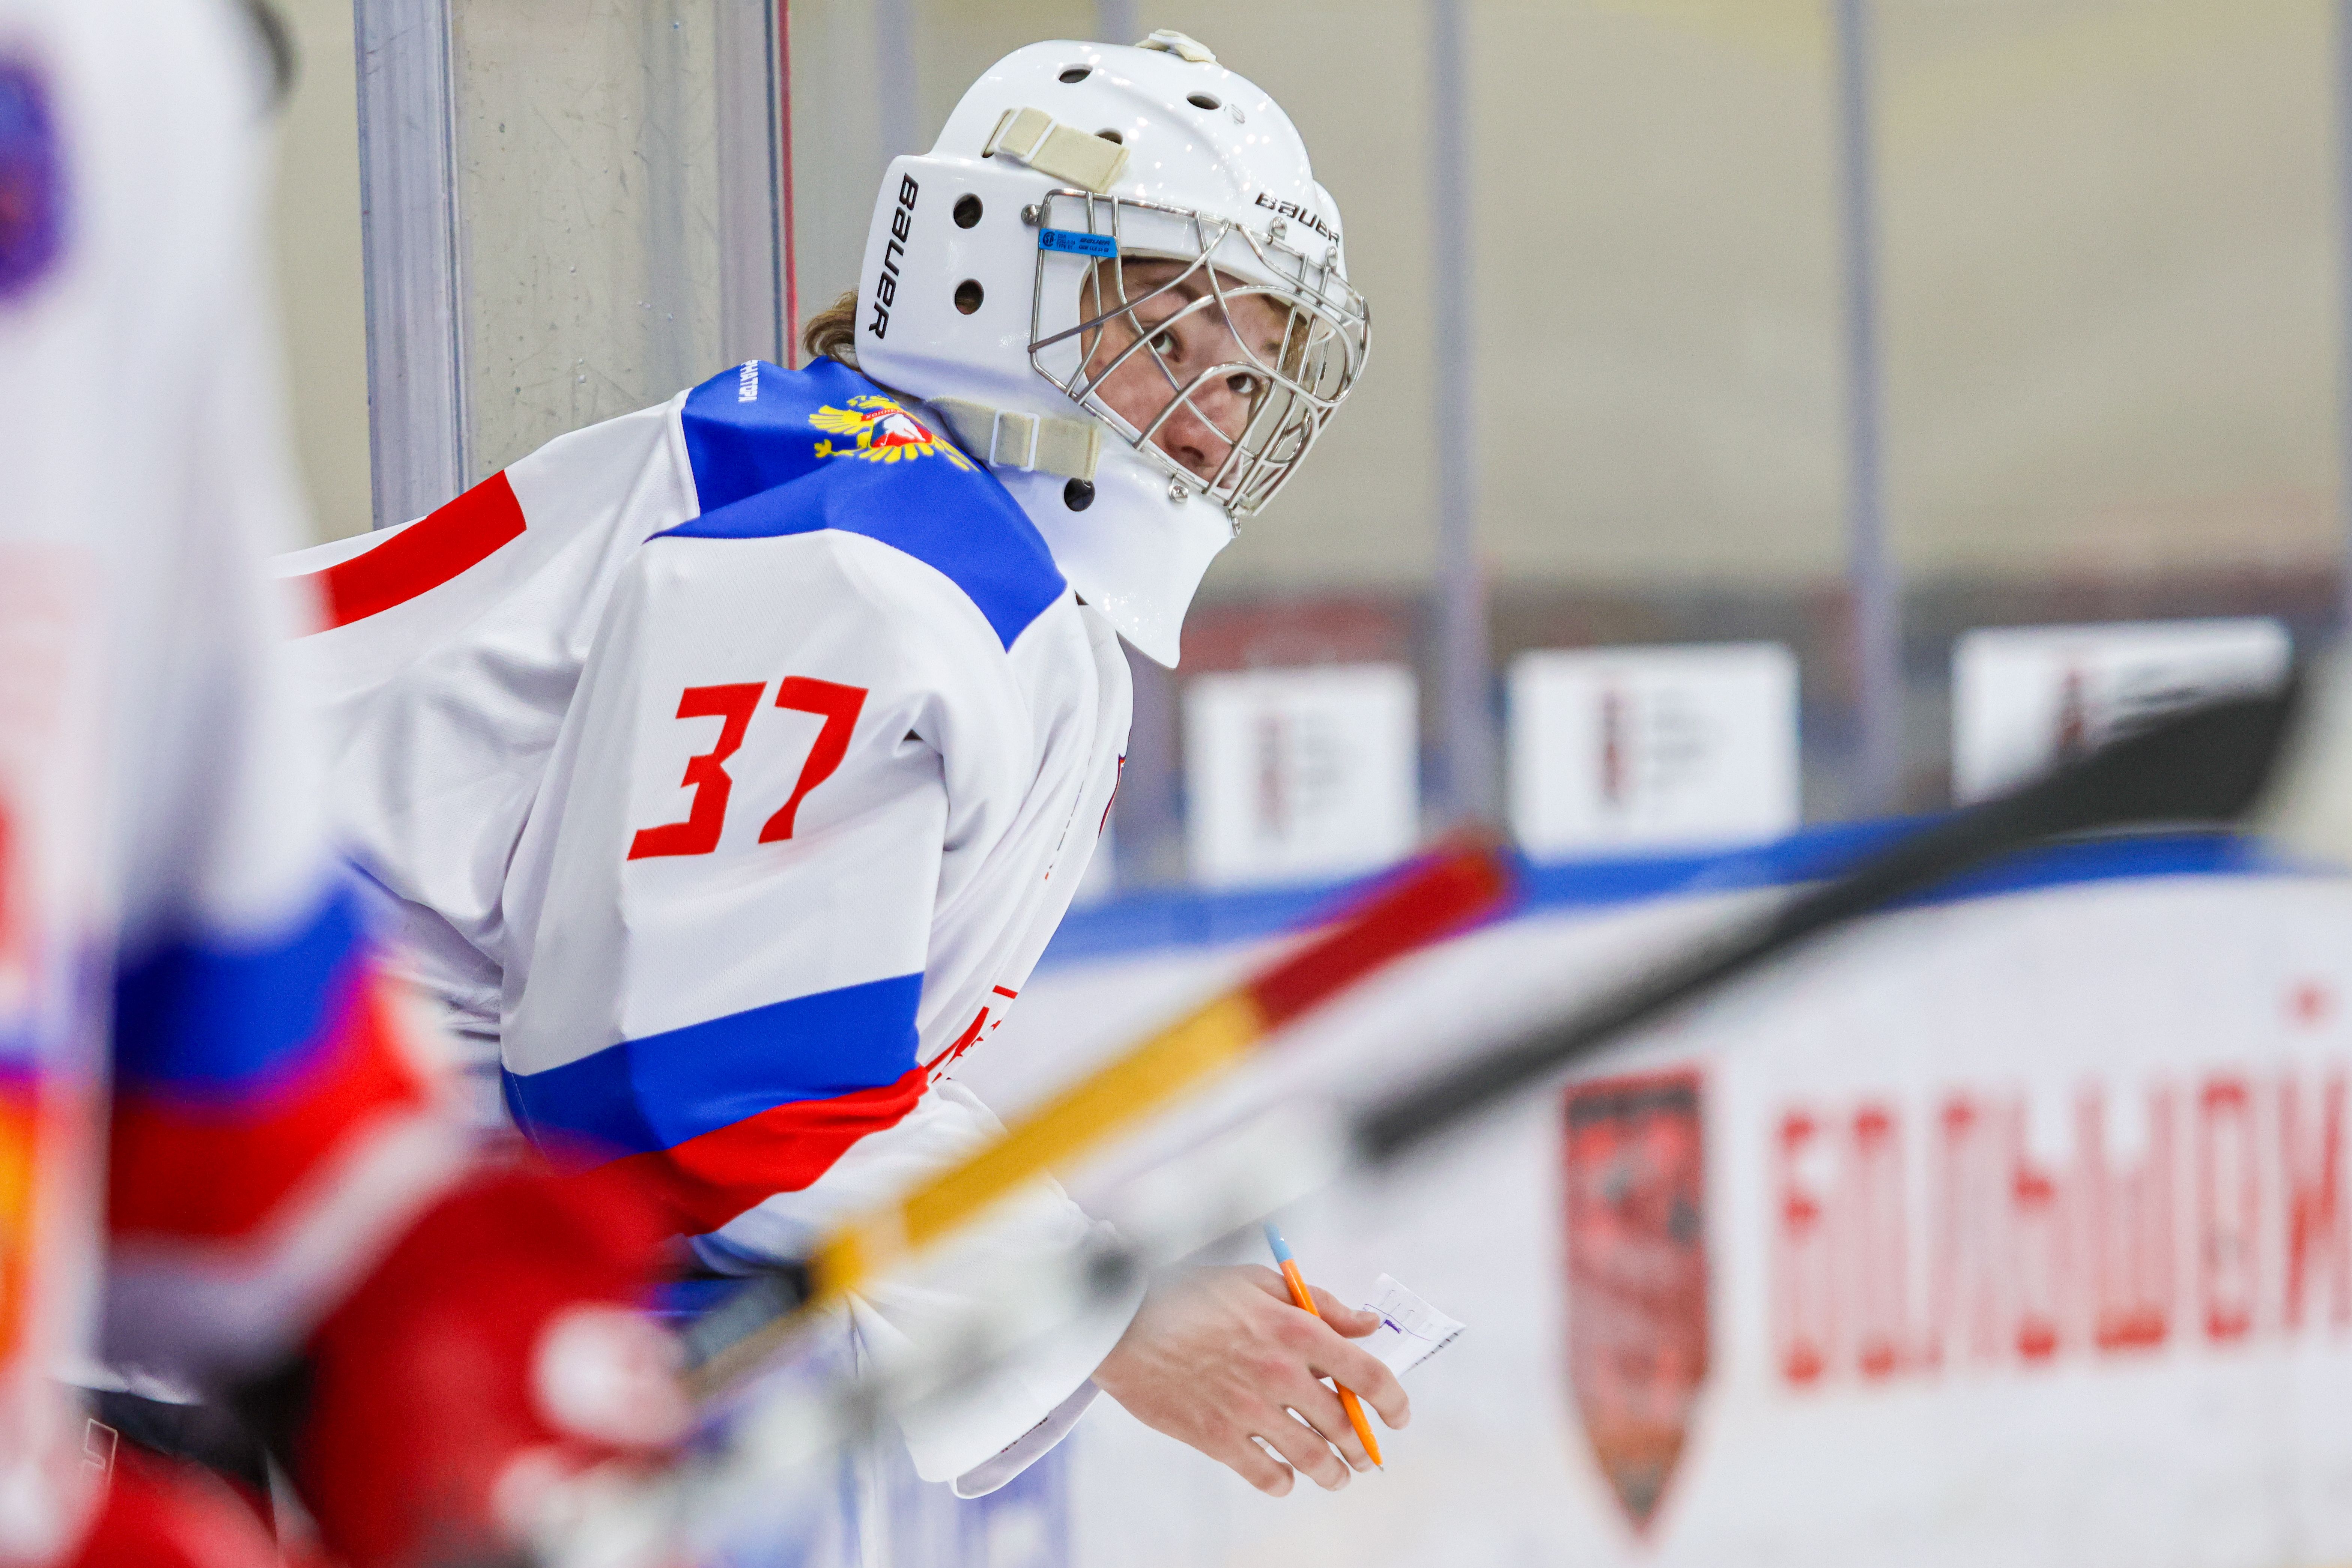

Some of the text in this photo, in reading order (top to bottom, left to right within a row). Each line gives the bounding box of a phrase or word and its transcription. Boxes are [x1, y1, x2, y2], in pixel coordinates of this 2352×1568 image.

[869, 172, 919, 339] BAUER
[1080, 238, 1111, 246] BAUER
[1254, 191, 1340, 248] BAUER
[627, 675, 869, 861] 37
